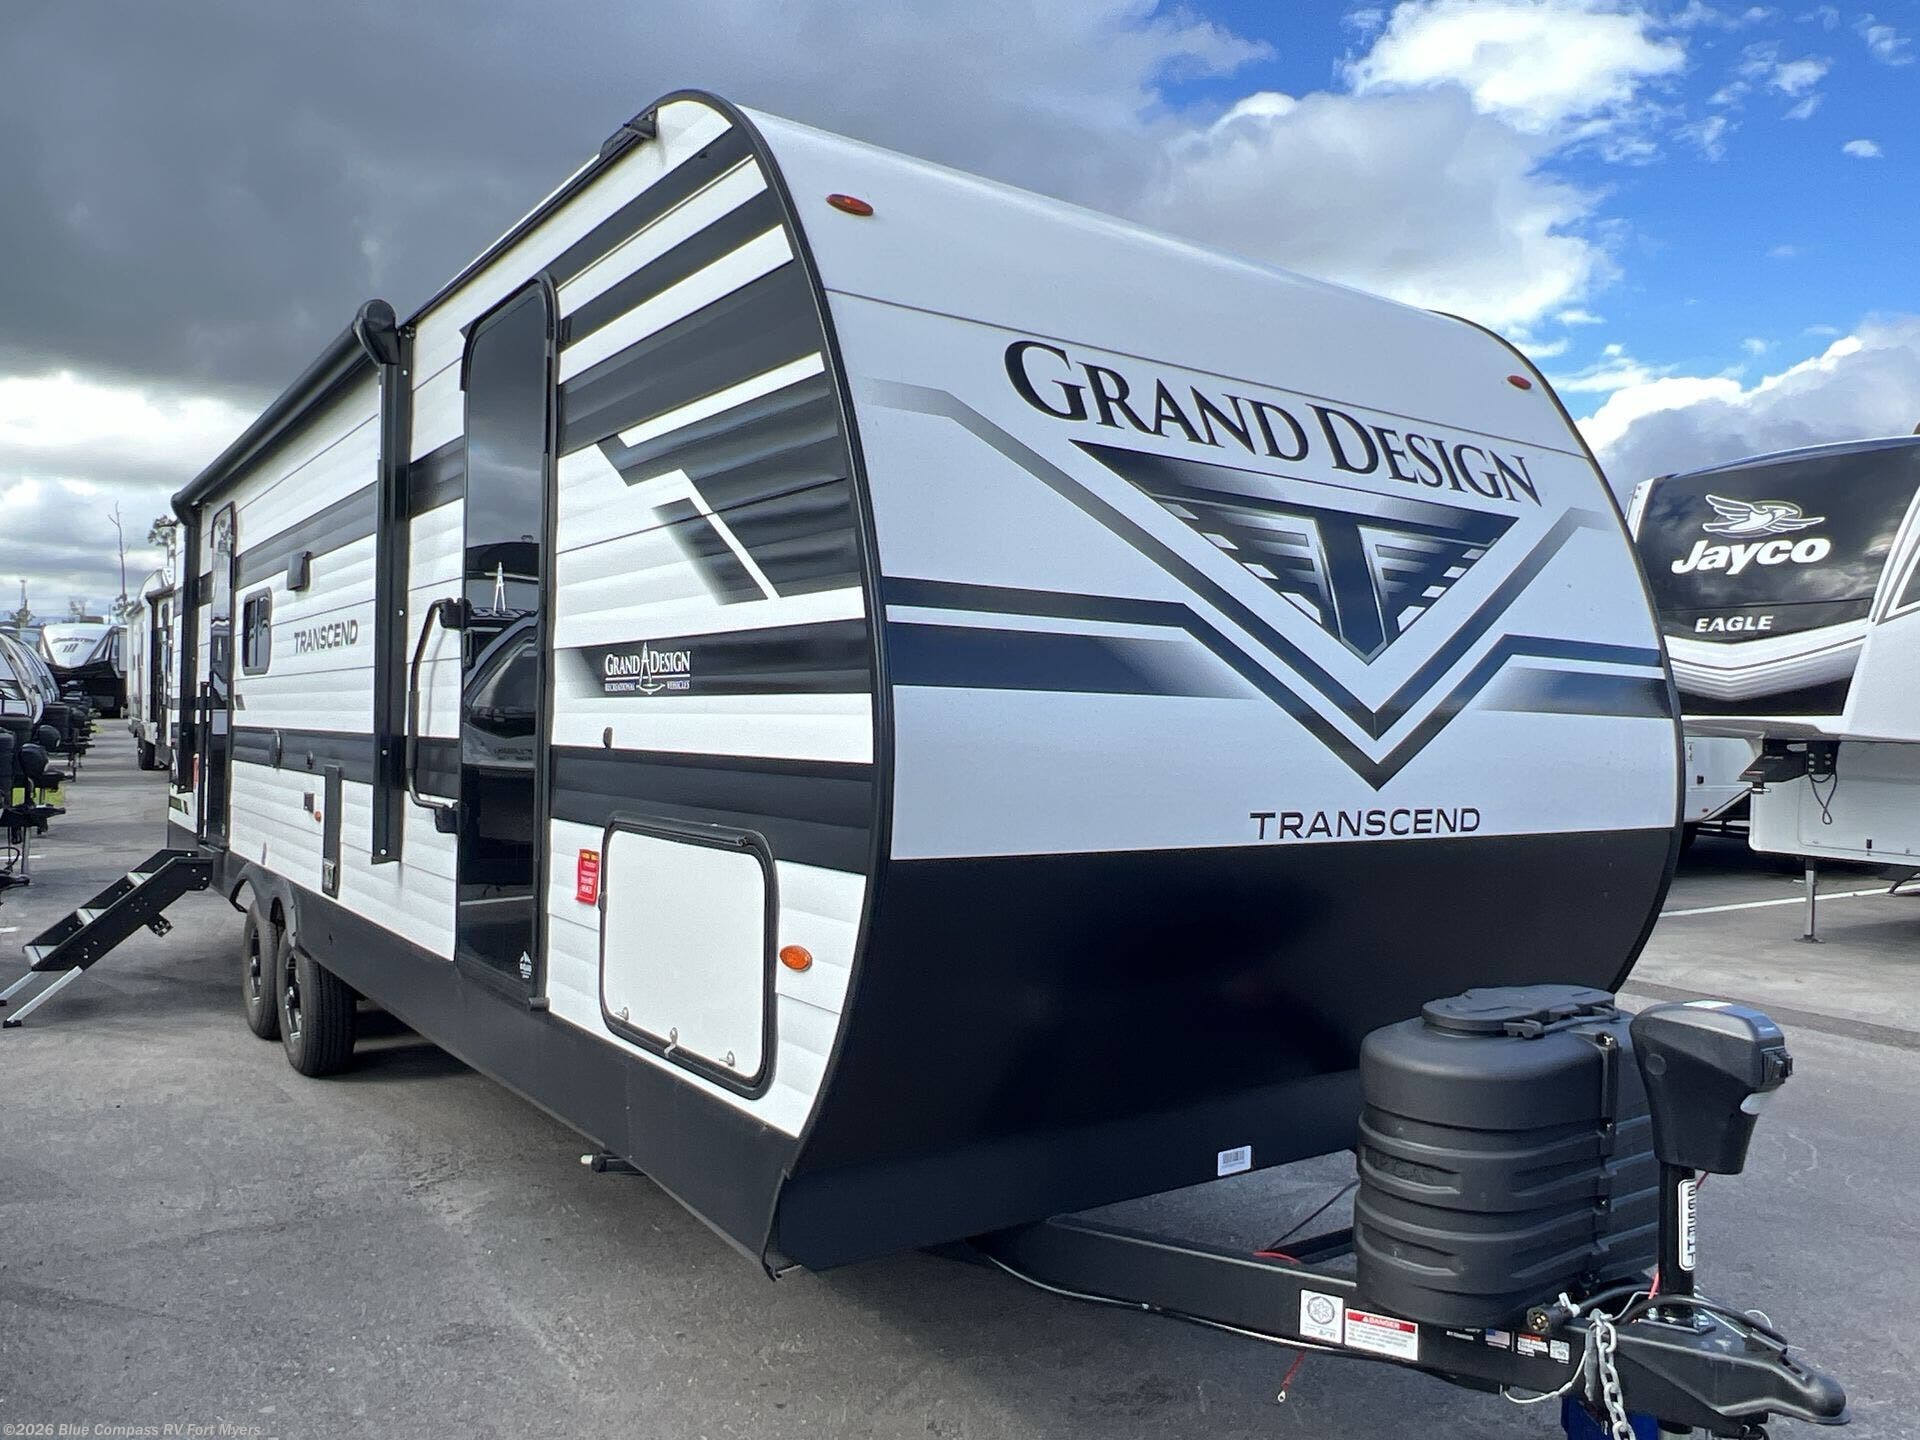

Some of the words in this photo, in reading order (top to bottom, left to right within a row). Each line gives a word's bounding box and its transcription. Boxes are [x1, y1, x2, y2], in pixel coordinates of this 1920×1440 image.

[1004, 340, 1309, 461] GRAND
[1305, 402, 1543, 507] DESIGN
[1671, 538, 1831, 575] Jayco
[293, 619, 358, 654] TRANSCEND
[1694, 615, 1774, 632] EAGLE
[605, 653, 640, 676] GRAND
[650, 650, 691, 673] DESIGN
[1249, 808, 1481, 840] TRANSCEND
